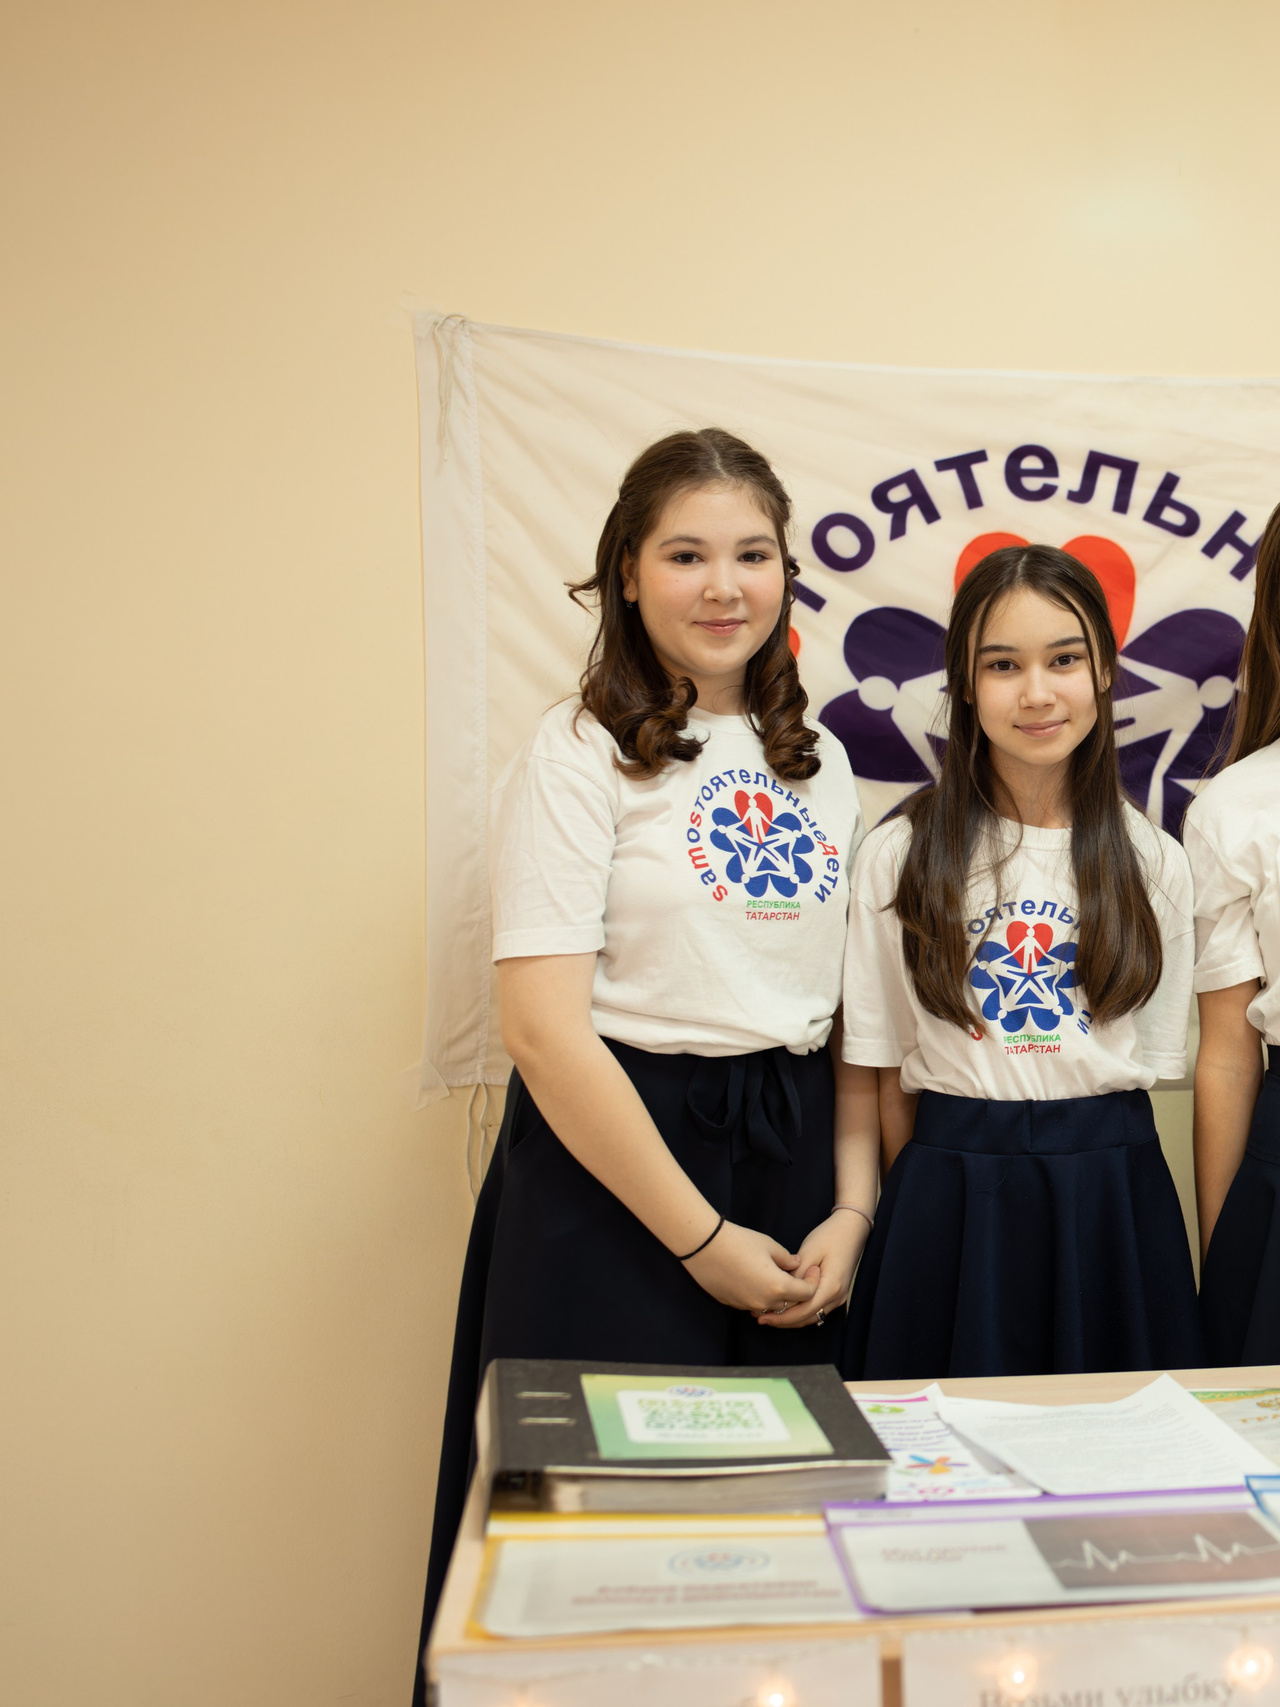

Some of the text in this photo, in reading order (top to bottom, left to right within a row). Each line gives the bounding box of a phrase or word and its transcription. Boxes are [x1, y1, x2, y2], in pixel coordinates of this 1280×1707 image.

[746, 899, 801, 909] РЕСПУБЛИКА
[745, 911, 801, 921] ТАТАРСТАН
[1115, 1671, 1238, 1707] улыбку
